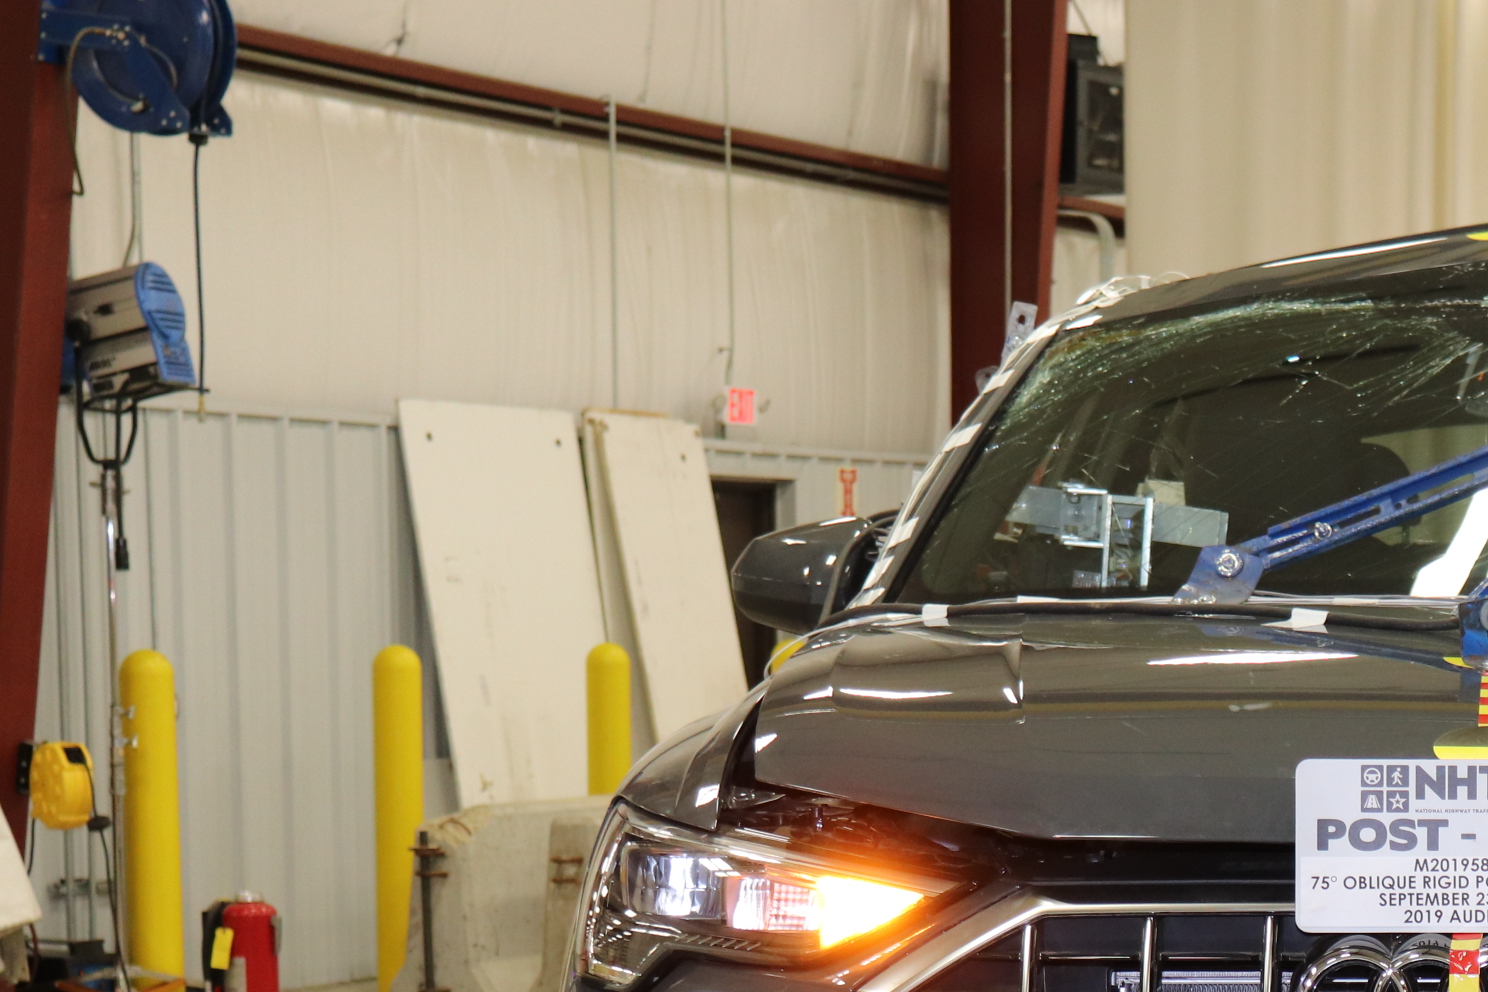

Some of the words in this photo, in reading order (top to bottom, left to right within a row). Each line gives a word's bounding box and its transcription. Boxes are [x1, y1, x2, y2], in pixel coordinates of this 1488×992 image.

[1316, 817, 1449, 852] POST
[1343, 875, 1417, 891] OBLIQUE
[1422, 875, 1469, 890] RIGID
[1379, 892, 1470, 907] SEPTEMBER
[1403, 909, 1444, 924] 2019
